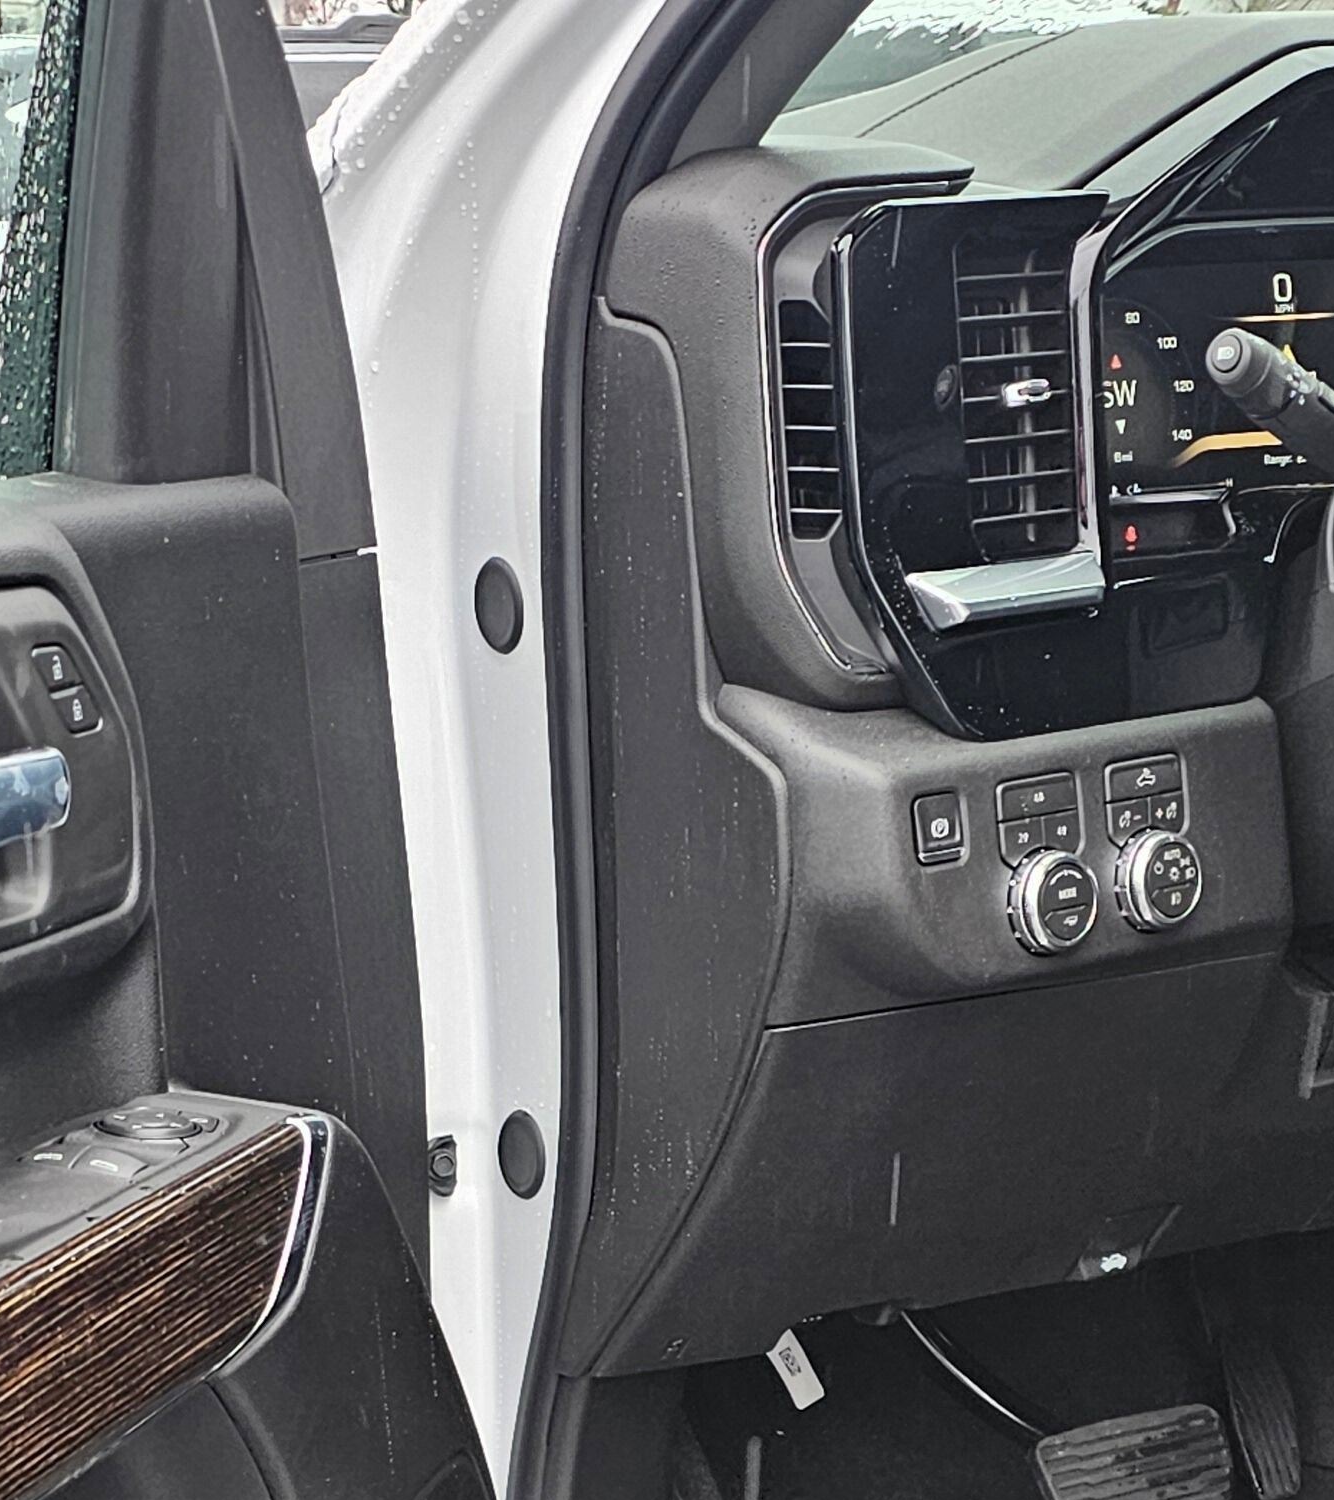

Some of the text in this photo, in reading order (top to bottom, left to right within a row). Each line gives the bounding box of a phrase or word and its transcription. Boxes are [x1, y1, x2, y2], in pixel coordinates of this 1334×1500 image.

[1272, 272, 1293, 303] 0
[1125, 311, 1140, 324] 80
[1156, 336, 1178, 349] 100
[1173, 380, 1195, 392] 120
[1171, 428, 1193, 441] 140
